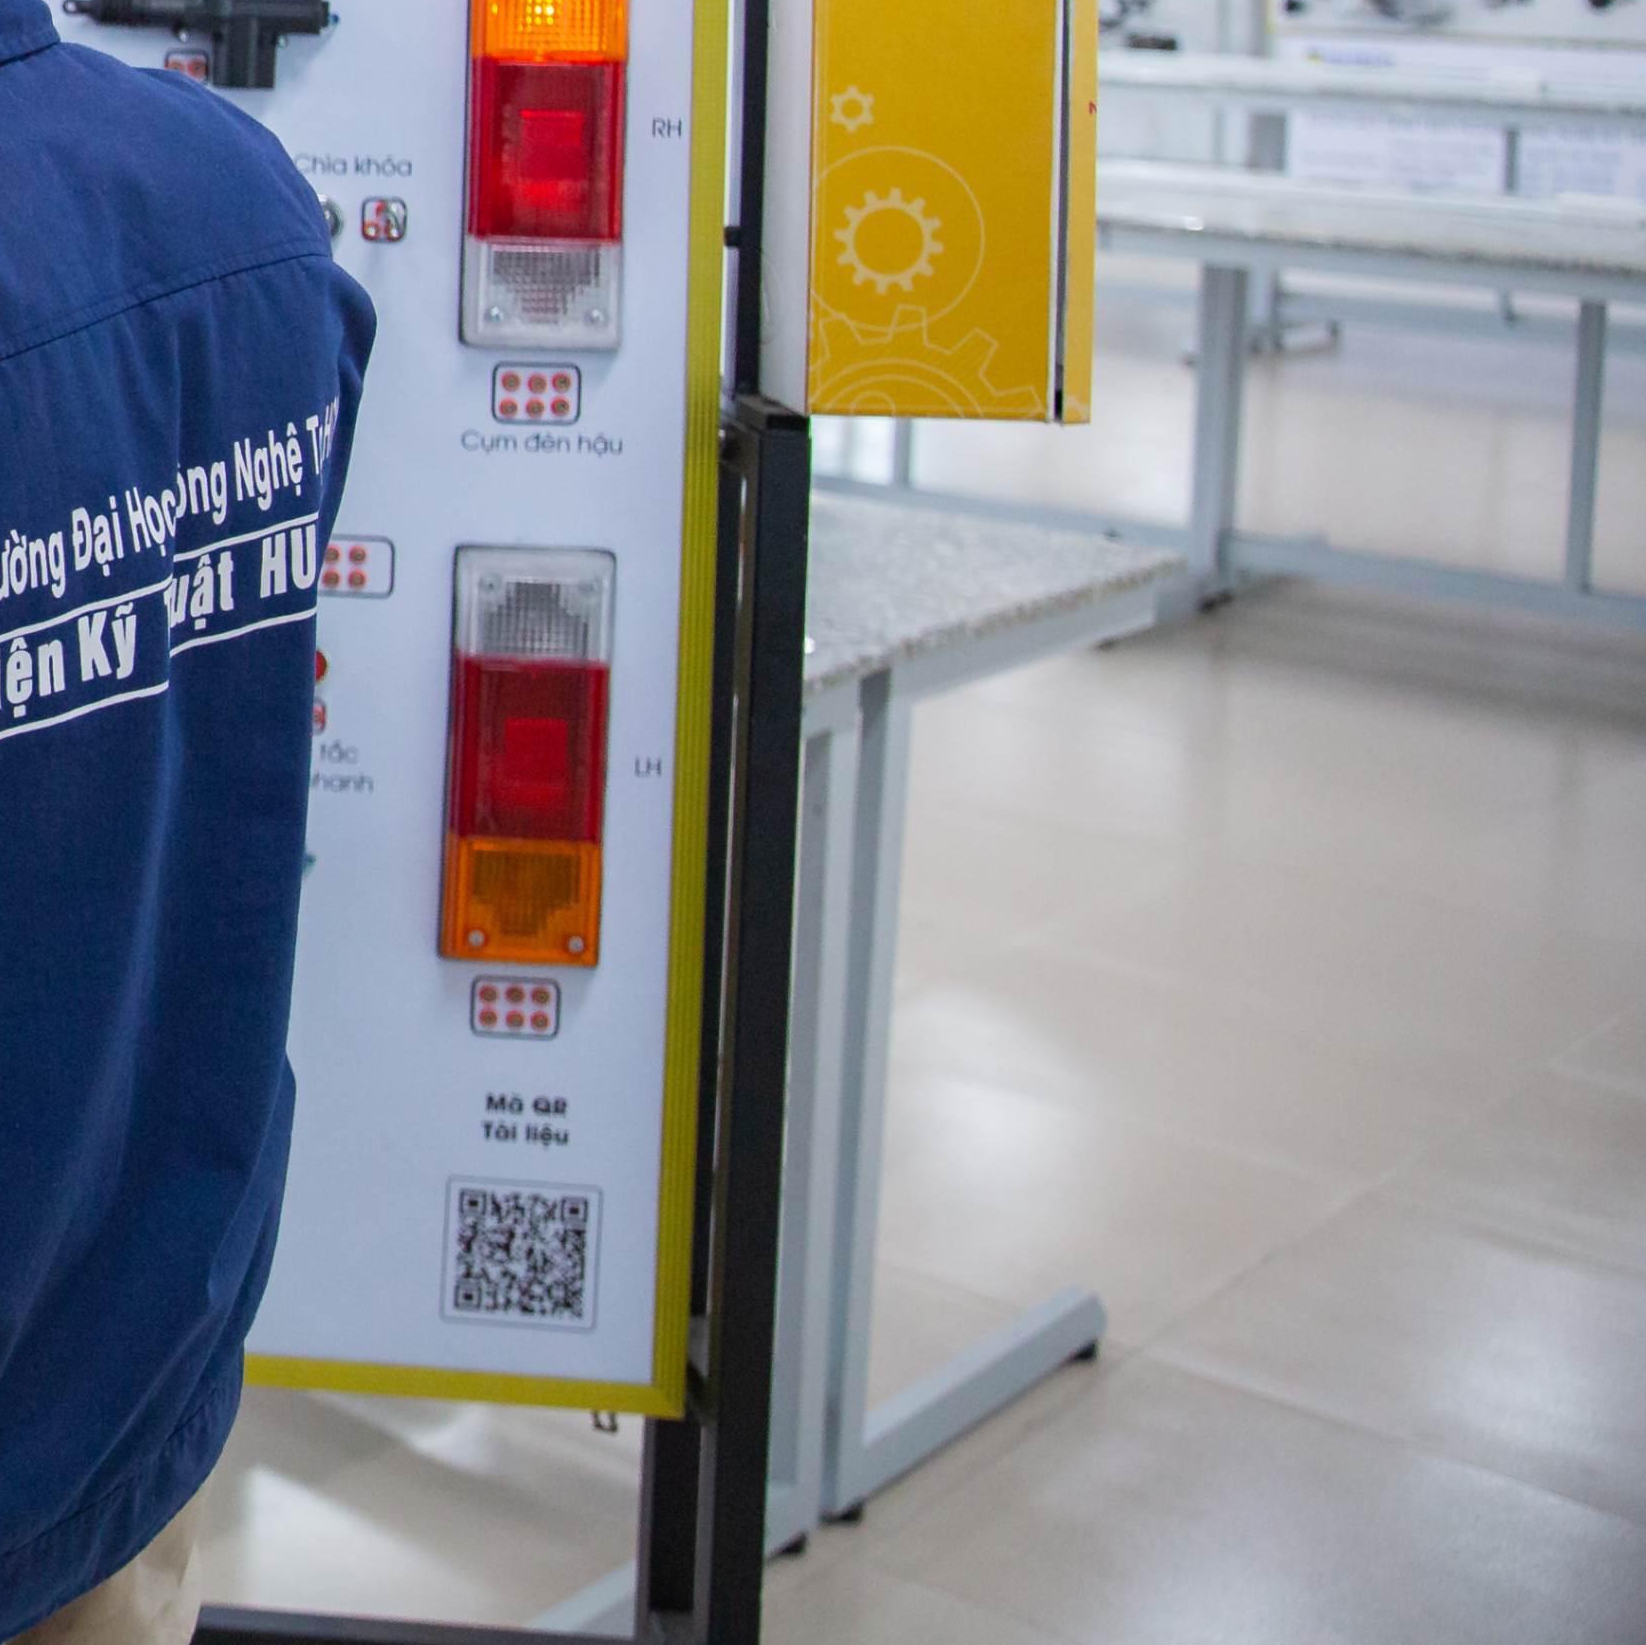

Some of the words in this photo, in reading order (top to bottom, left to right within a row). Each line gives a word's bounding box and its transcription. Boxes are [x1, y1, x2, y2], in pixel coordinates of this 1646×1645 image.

[652, 118, 682, 138] RH
[461, 430, 518, 456] Cụm
[524, 429, 571, 453] đèn
[578, 432, 623, 462] hậu
[71, 496, 125, 577] Đại
[126, 485, 178, 558] Học
[233, 422, 303, 511] Nghệ
[77, 602, 137, 680] Kỹ
[635, 756, 662, 778] LH
[486, 1093, 524, 1114] Mã
[532, 1097, 568, 1117] QR
[526, 1123, 570, 1148] liệu
